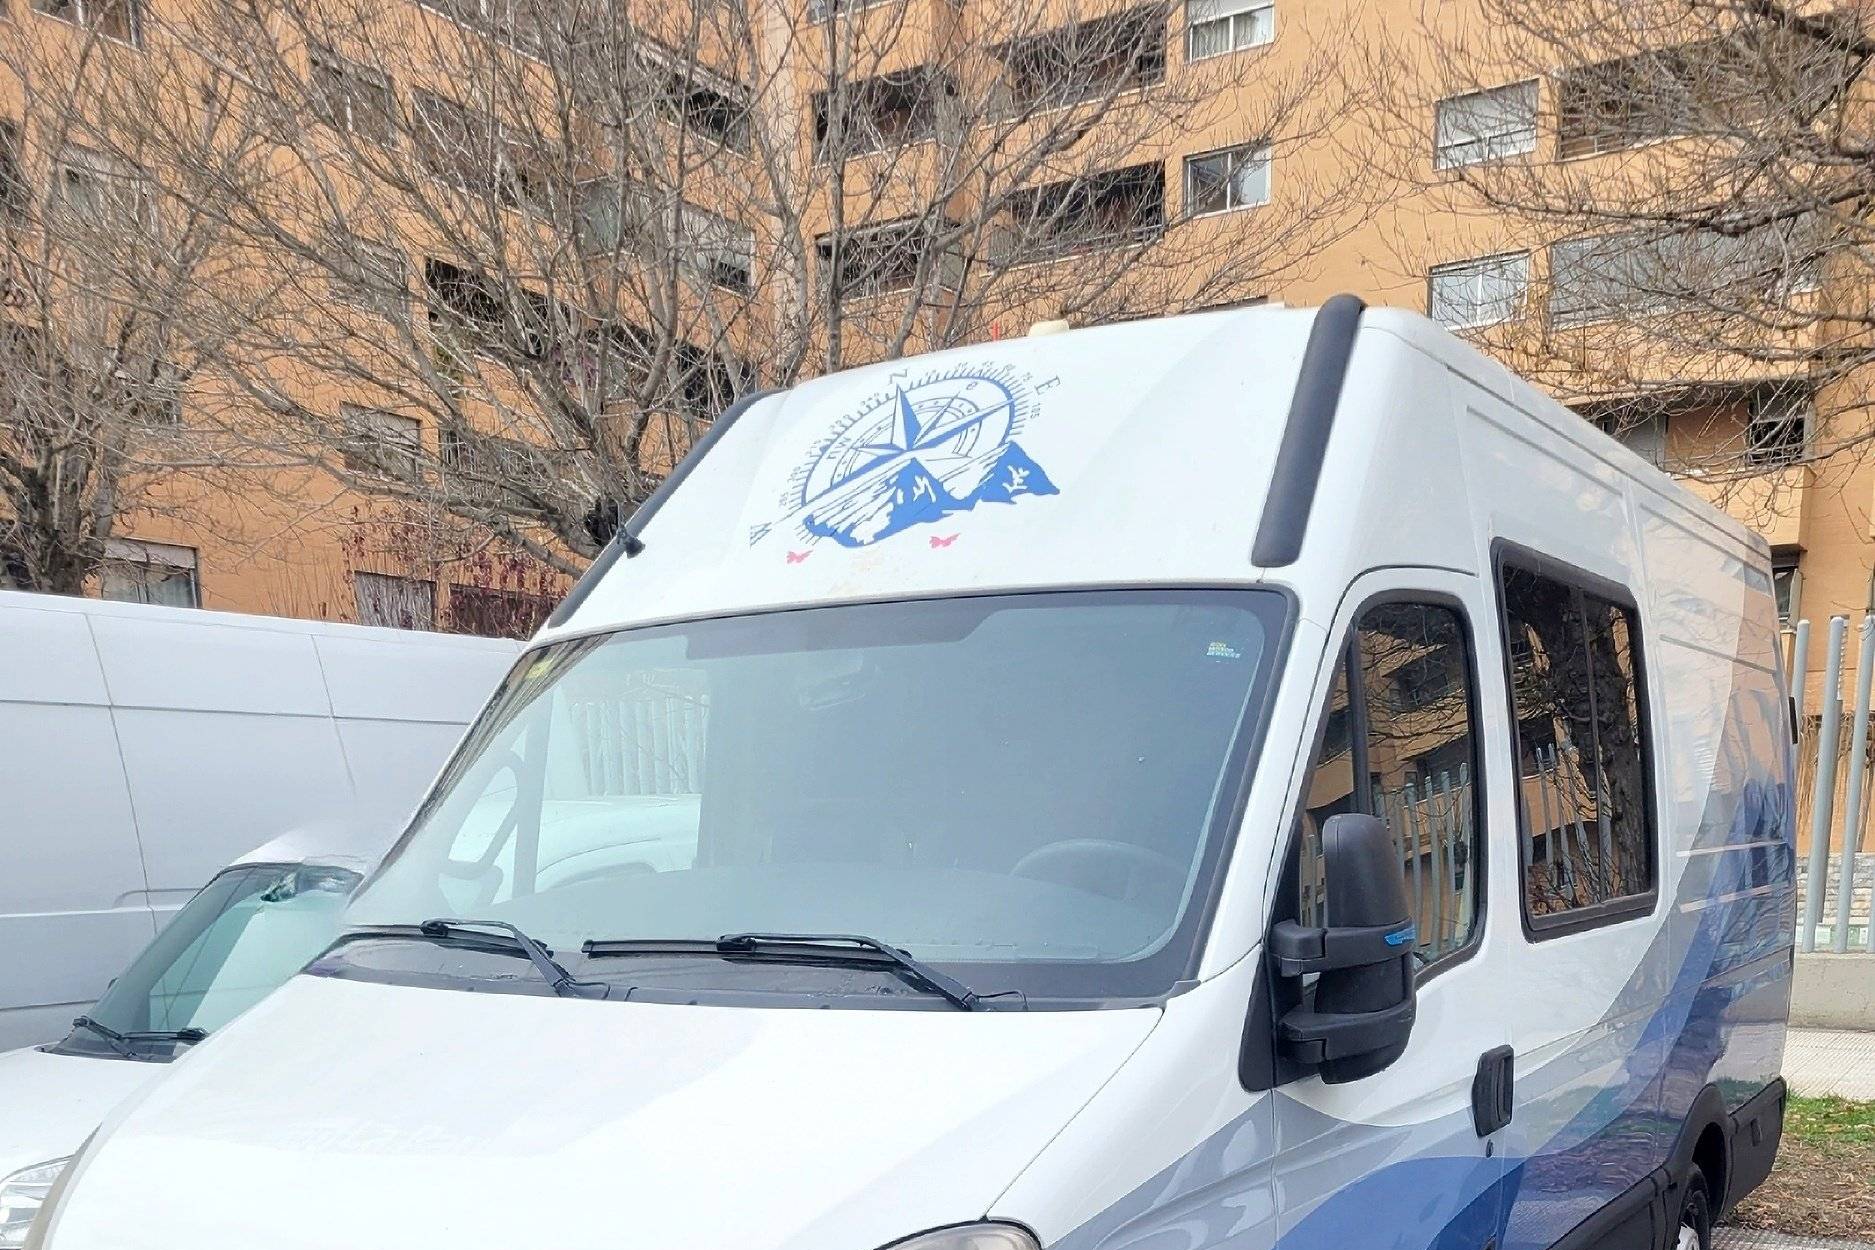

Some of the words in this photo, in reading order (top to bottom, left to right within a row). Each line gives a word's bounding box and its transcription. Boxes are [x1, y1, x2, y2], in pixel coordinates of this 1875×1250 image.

[888, 368, 908, 385] N
[1034, 375, 1061, 396] E
[749, 521, 773, 550] W
